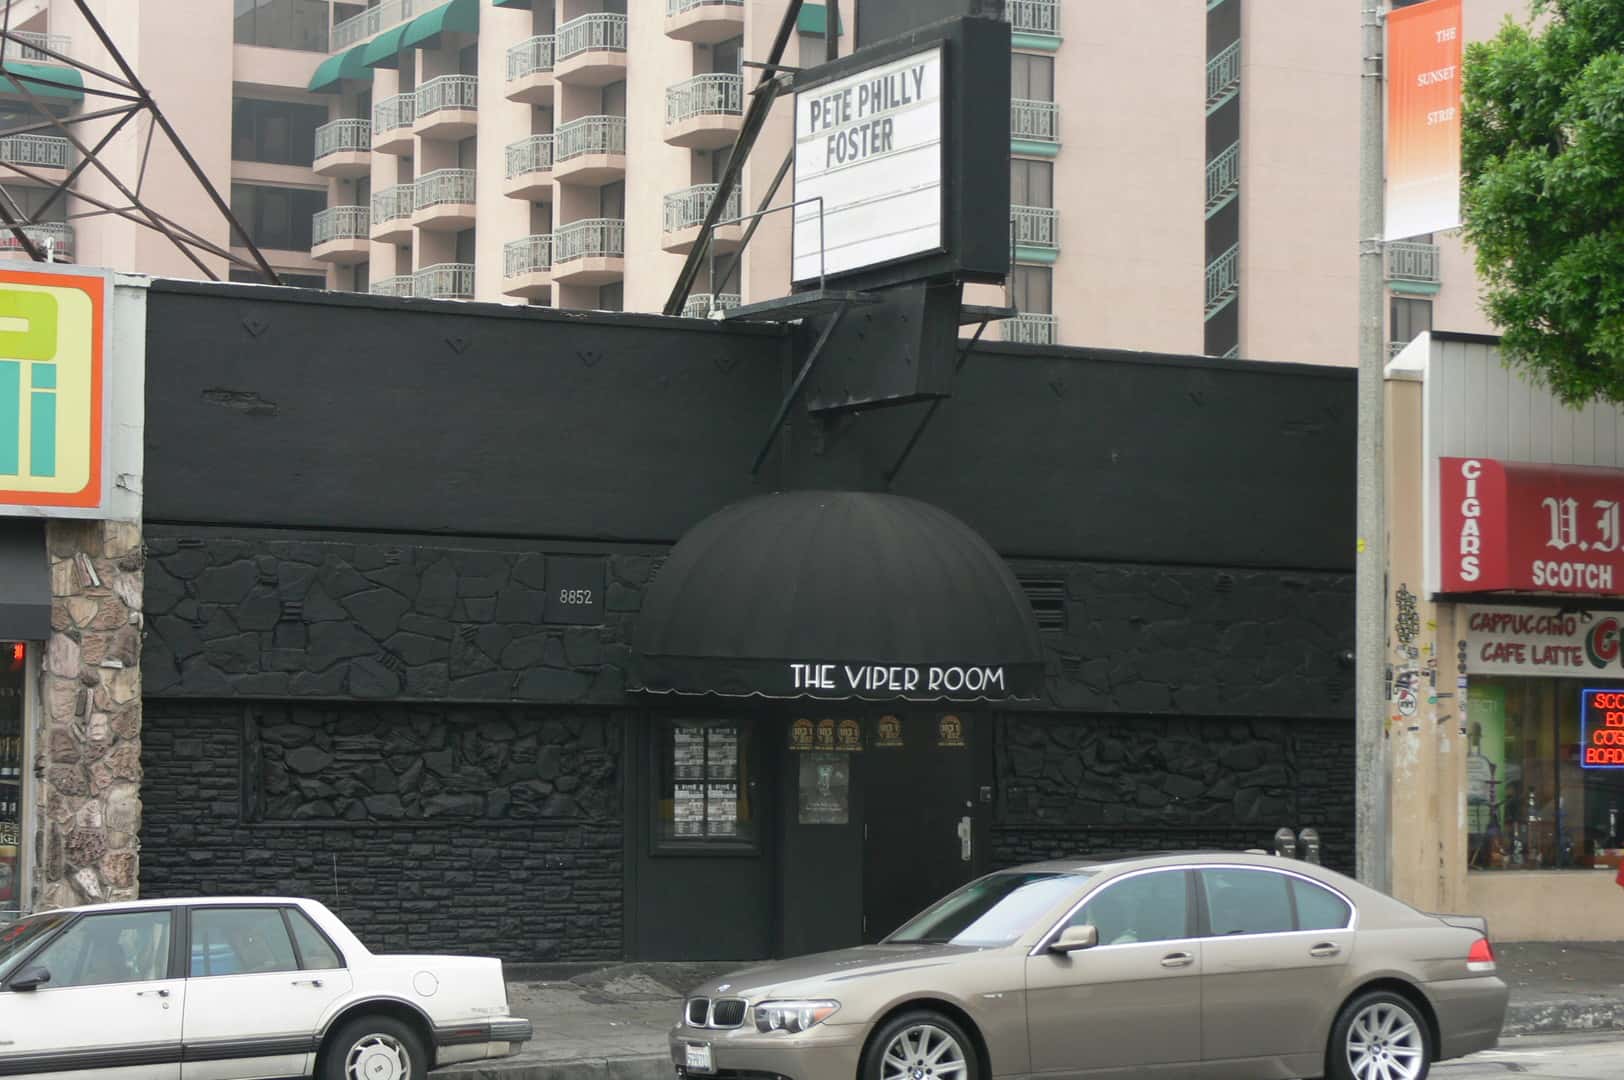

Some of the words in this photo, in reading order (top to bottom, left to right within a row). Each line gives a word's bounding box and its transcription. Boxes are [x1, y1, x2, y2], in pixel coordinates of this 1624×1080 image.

[1436, 27, 1456, 43] THE
[1418, 66, 1456, 87] SUNSET
[810, 89, 852, 133] PETE
[859, 65, 925, 118] PHILLY
[1427, 108, 1455, 126] STRIP
[826, 118, 894, 169] FOSTER
[1460, 459, 1481, 582] CIGARS
[1532, 560, 1613, 590] SCOTCH
[560, 589, 593, 605] 8852
[1470, 612, 1577, 636] CAPPUCCINO
[1480, 641, 1526, 664] CAFE
[1531, 645, 1584, 667] LATTE
[790, 664, 836, 689] THE
[844, 666, 920, 690] VIPER
[928, 667, 1004, 691] ROOM
